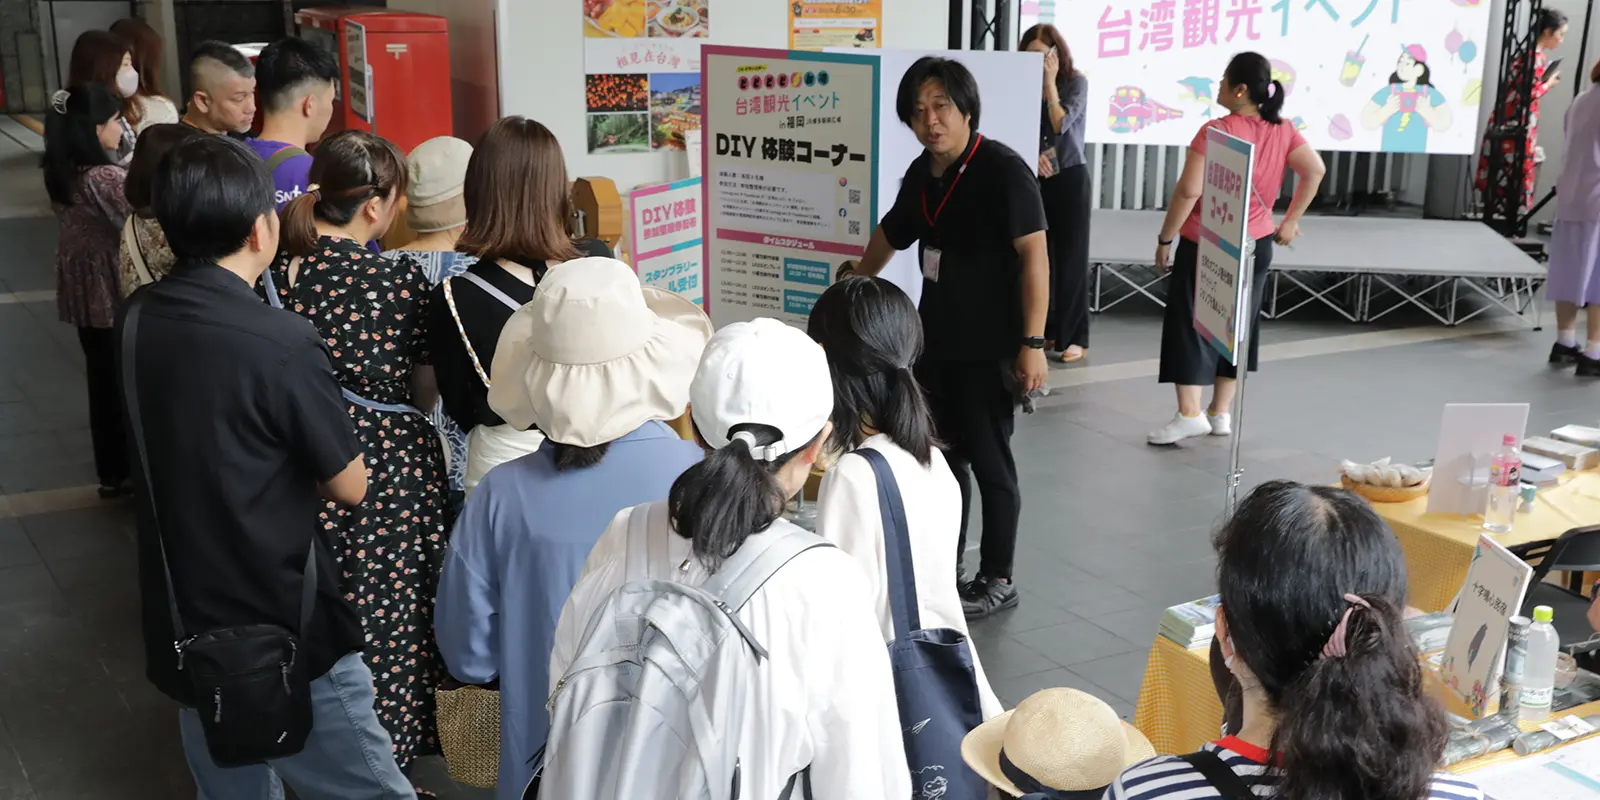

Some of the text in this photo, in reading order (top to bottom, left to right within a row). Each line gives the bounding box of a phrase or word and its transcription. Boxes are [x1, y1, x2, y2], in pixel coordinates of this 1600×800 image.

[736, 91, 840, 116] 台湾観光イベント
[787, 116, 805, 129] 福岡
[716, 133, 866, 167] DIY 体験コーナー
[1210, 194, 1234, 227] コーナー
[645, 261, 698, 283] スタンプラリー
